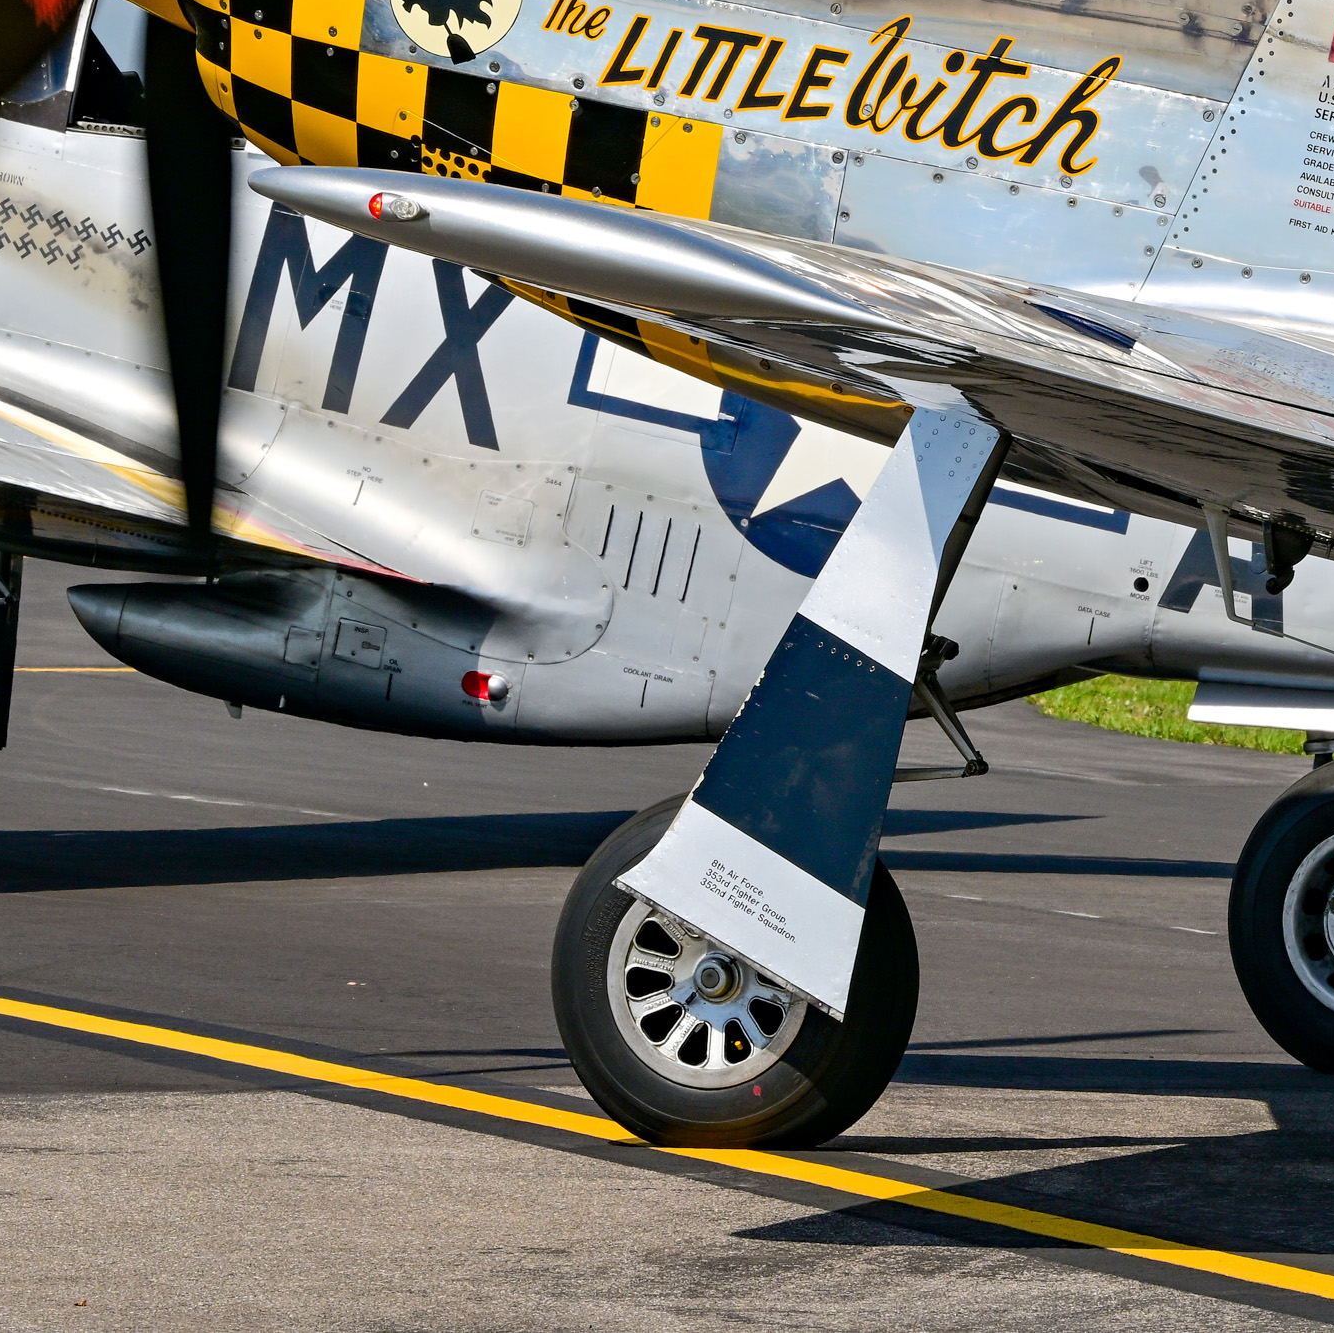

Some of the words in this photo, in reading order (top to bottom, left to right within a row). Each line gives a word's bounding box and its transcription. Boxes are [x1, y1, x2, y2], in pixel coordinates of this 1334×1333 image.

[600, 15, 850, 121] LITTLE
[844, 16, 1123, 176] Witch
[1303, 157, 1334, 172] GRADE
[1293, 198, 1332, 214] SUITABLE
[1289, 218, 1312, 230] FIRST
[1314, 224, 1329, 234] AID
[227, 200, 517, 451] MX
[346, 469, 362, 478] STEP
[367, 475, 383, 485] HERE
[362, 466, 372, 474] NO
[544, 477, 562, 487] 3464
[1139, 558, 1154, 567] LIFT
[1129, 567, 1145, 576] 1600
[1129, 592, 1150, 602] MOOR
[1077, 605, 1094, 615] DATA
[1095, 609, 1112, 618] CASE
[384, 665, 402, 674] DRAIN
[623, 667, 652, 679] COOLANT
[653, 673, 674, 684] DRAIN
[711, 859, 726, 873] 8th
[727, 869, 739, 881] Air
[705, 868, 731, 888] 353rd
[731, 884, 760, 907] Fighter
[761, 903, 787, 926] Group,
[699, 877, 727, 898] 352nd
[727, 894, 756, 917] Fighter
[757, 913, 796, 944] Squadron.
